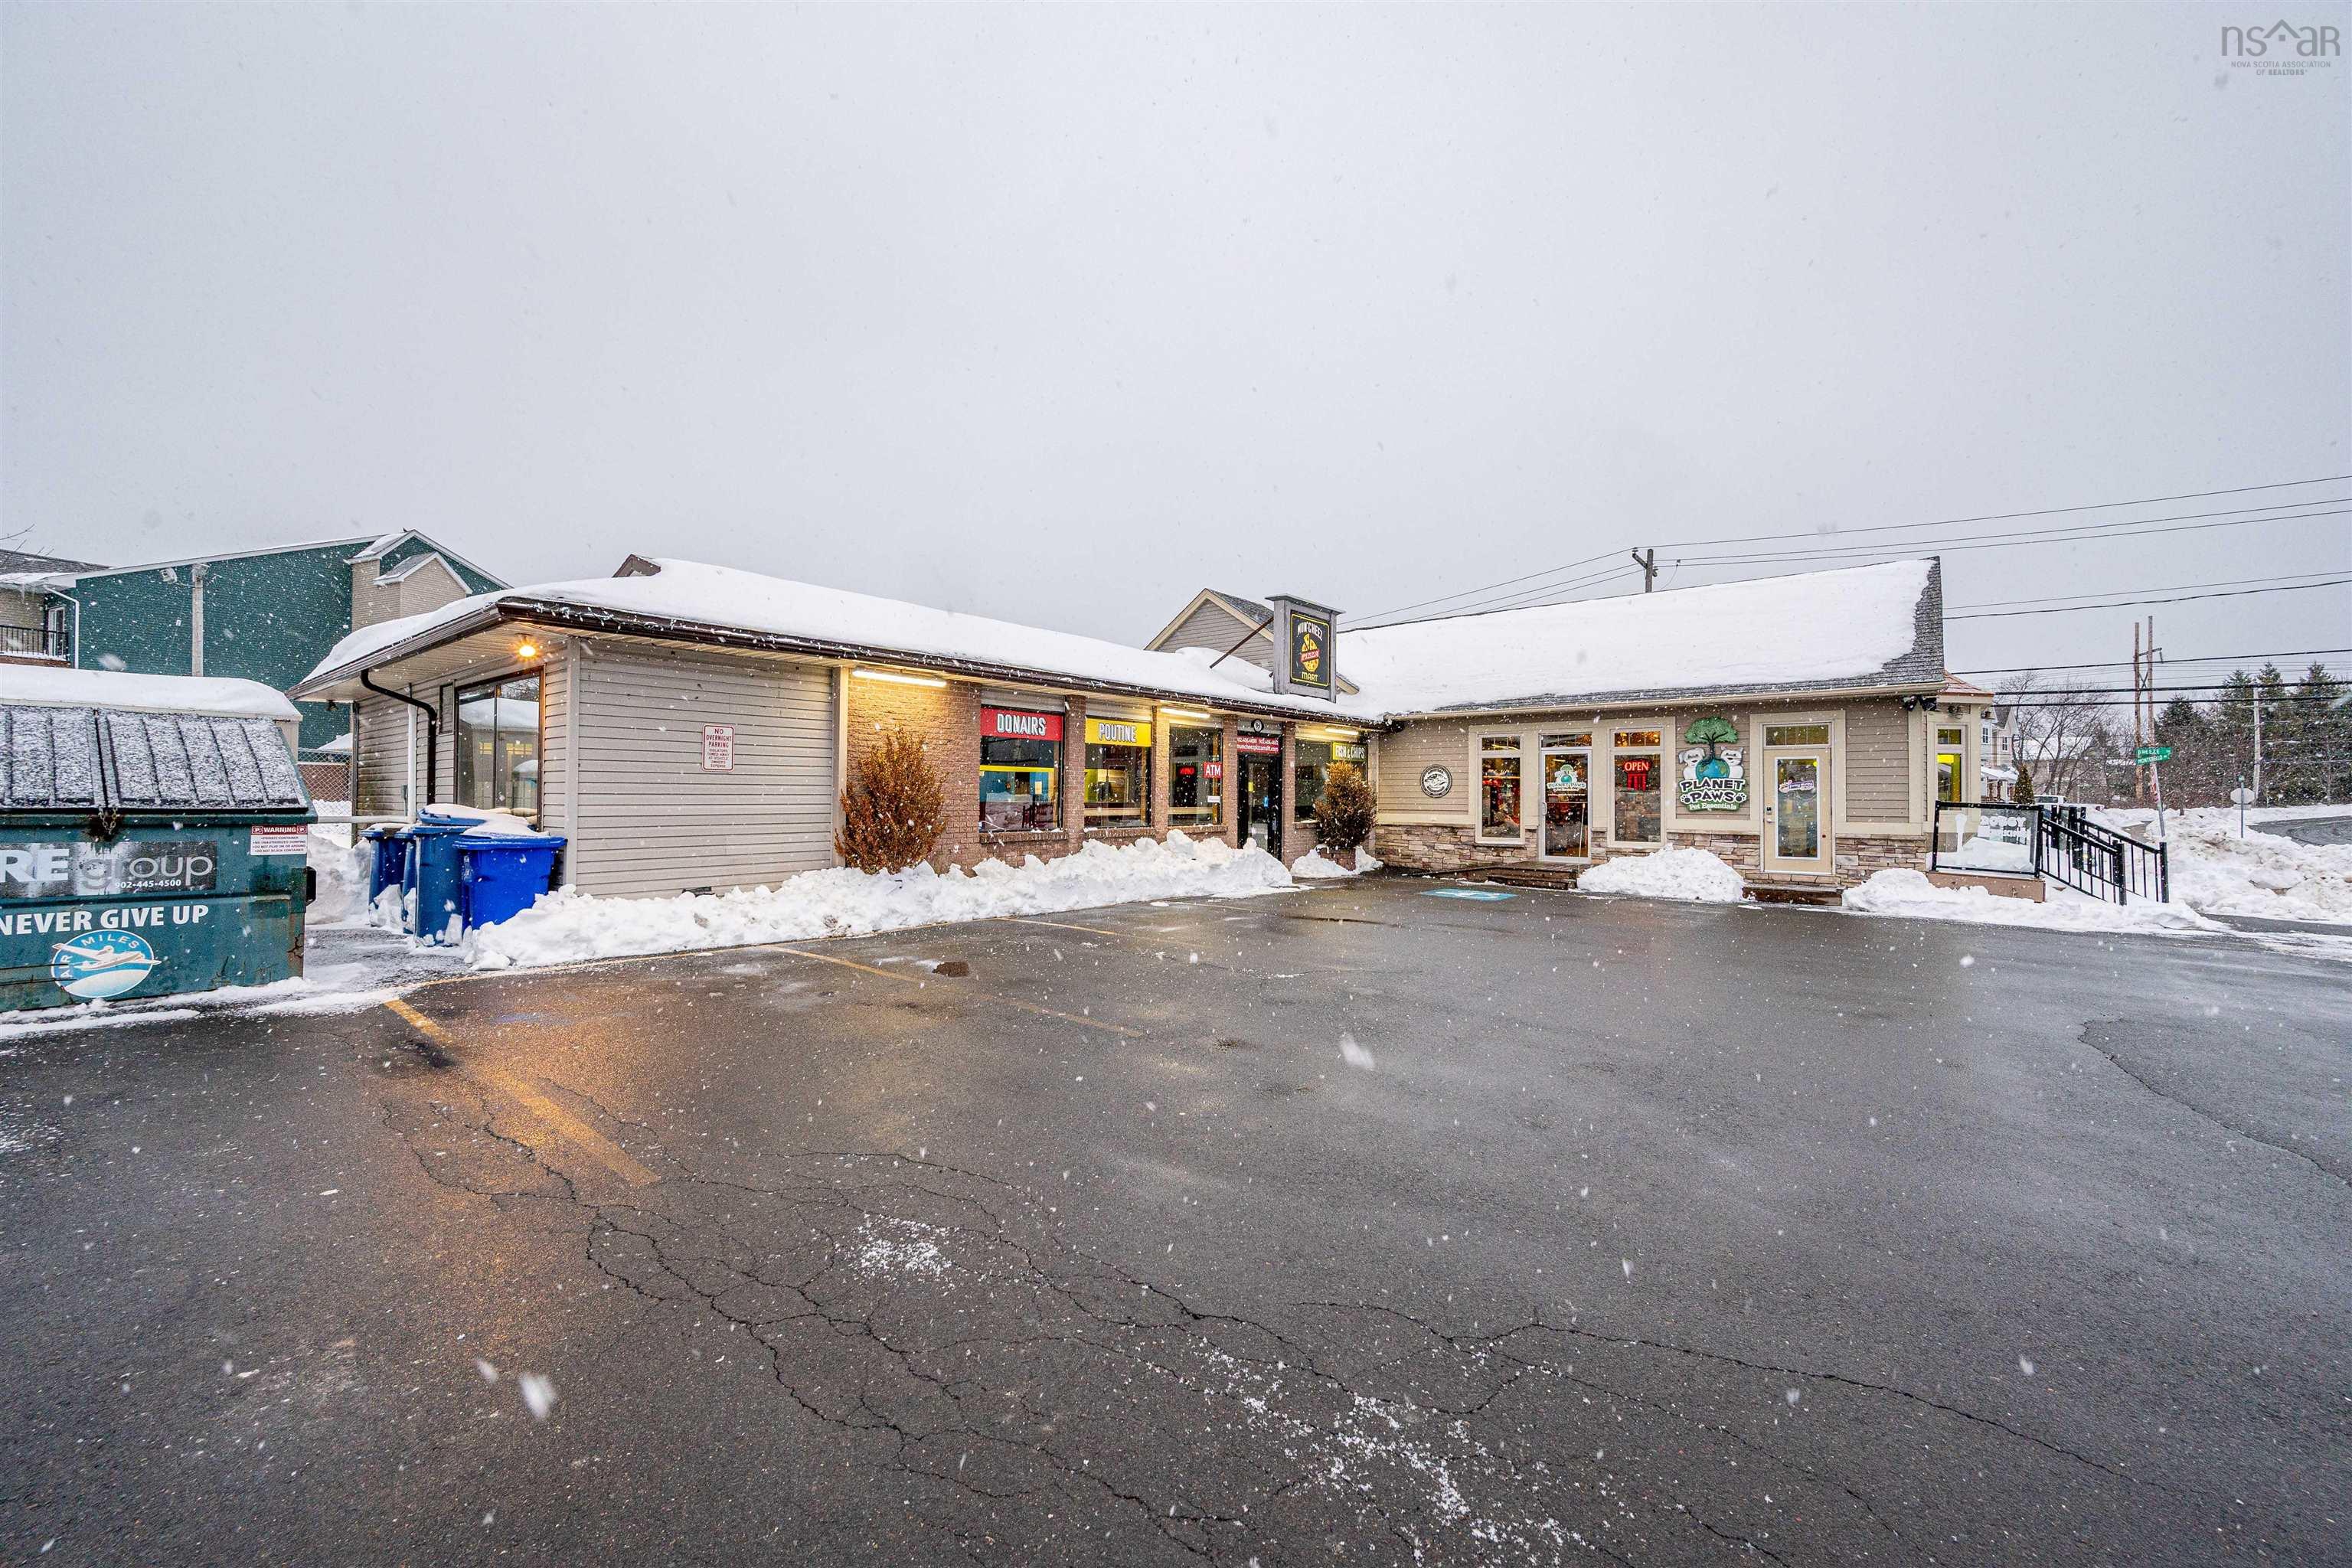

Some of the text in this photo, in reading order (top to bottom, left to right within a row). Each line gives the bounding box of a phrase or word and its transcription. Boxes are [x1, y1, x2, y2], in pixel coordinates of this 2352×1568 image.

[1302, 671, 1318, 681] MART
[997, 713, 1047, 736] DONAIRS
[1098, 723, 1137, 743] POUTINE
[1351, 746, 1365, 759] CHIPS
[1205, 764, 1221, 776] ATM
[1624, 761, 1649, 771] OPEN
[1680, 778, 1745, 792] PLANET
[1690, 791, 1734, 803] PAWS
[115, 879, 181, 890] 902-445-4500
[0, 904, 209, 936] NEVER GIVE UP
[59, 933, 139, 978] AIR MILES
